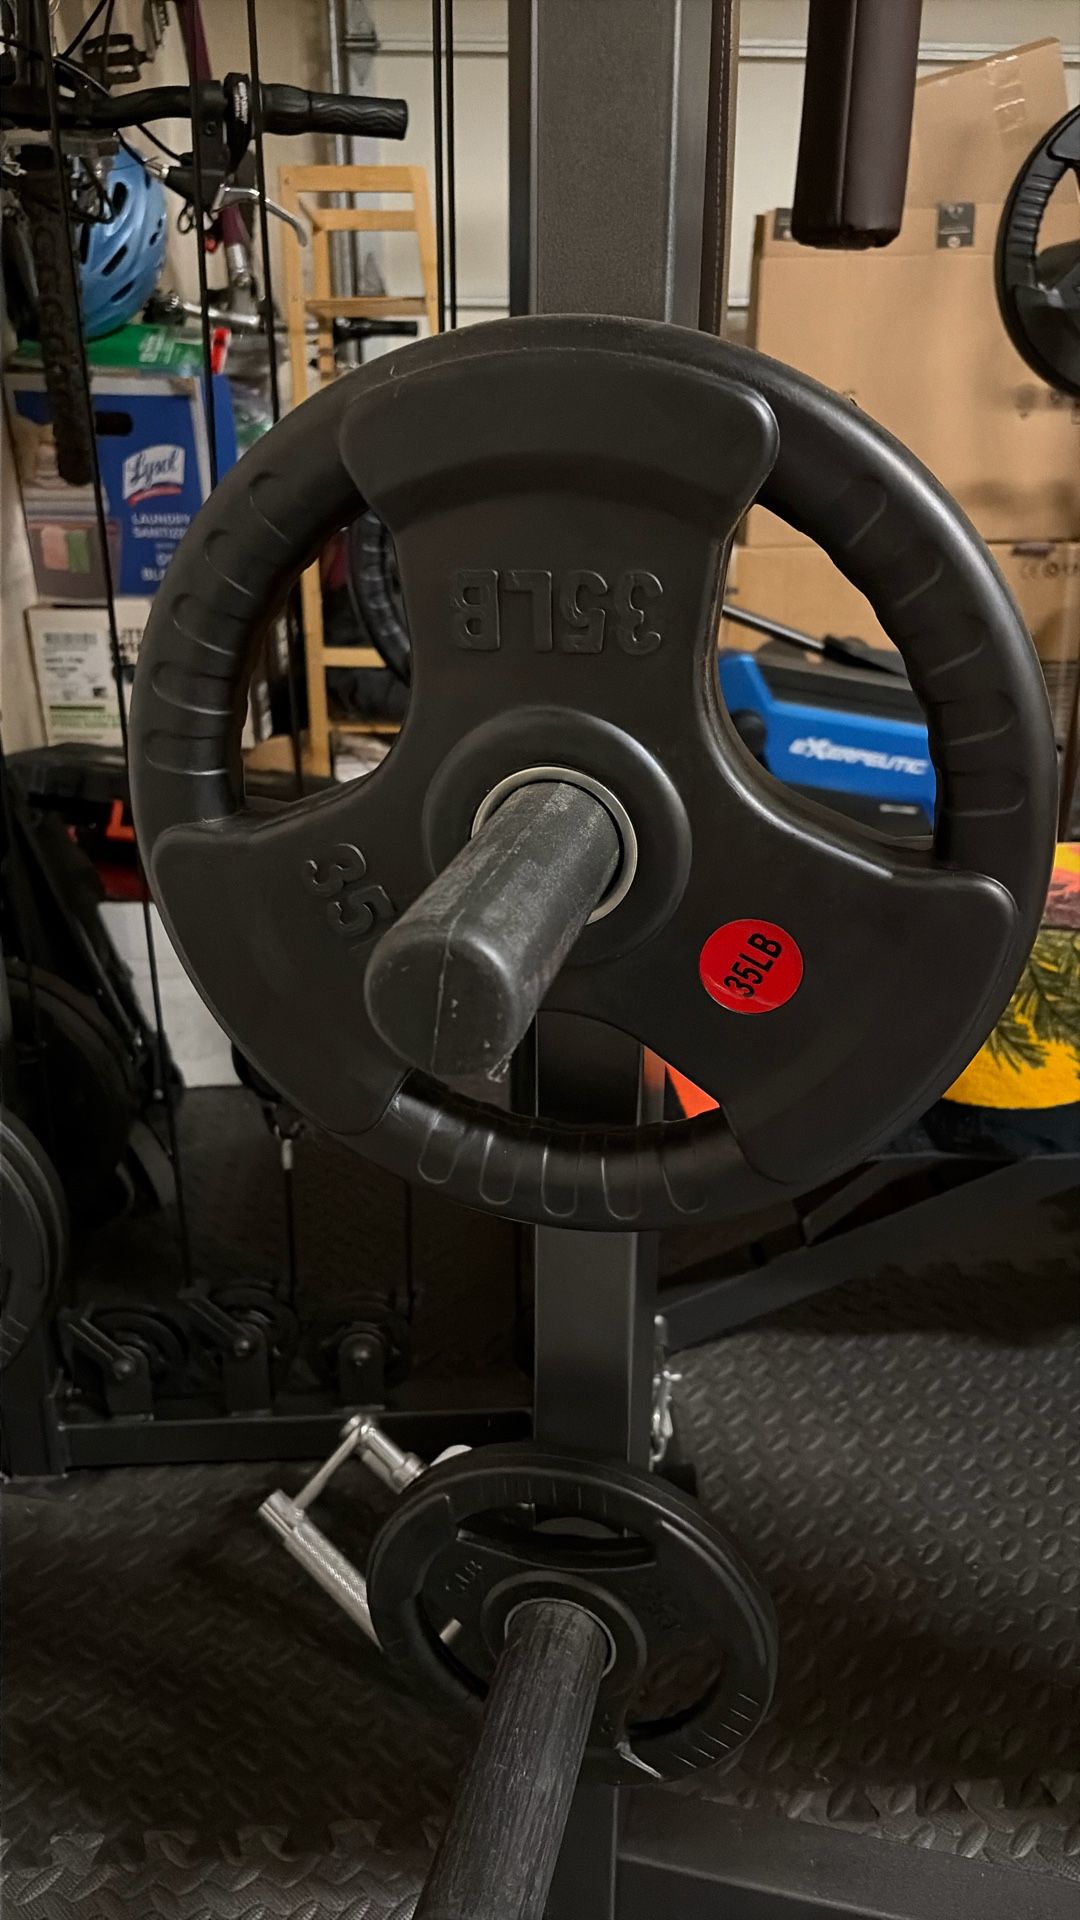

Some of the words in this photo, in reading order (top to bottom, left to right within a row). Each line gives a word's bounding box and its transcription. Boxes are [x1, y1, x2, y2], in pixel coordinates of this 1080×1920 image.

[130, 447, 180, 486] Lysol
[453, 568, 664, 656] 35LB
[303, 842, 397, 940] 35
[723, 932, 783, 998] 35LB
